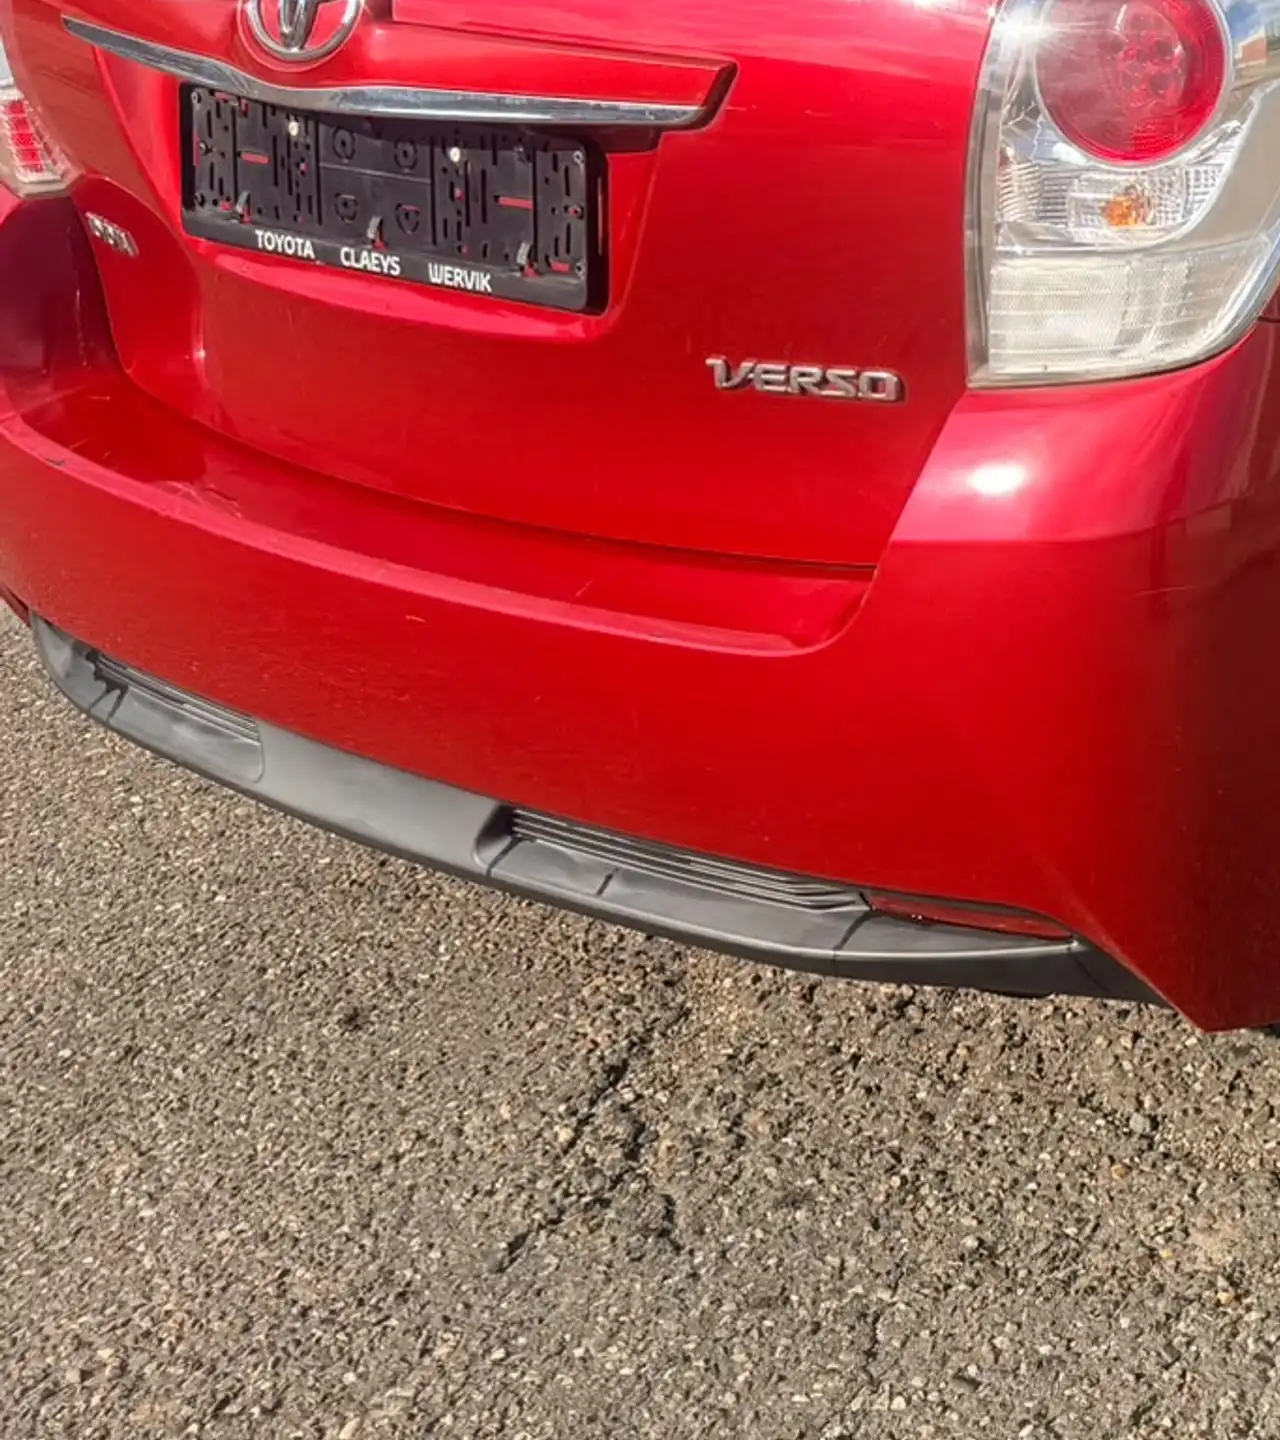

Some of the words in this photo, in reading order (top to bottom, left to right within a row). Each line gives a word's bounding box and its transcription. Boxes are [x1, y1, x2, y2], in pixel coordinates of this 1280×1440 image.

[255, 230, 315, 259] TOYOTA
[340, 247, 401, 276] CLAEYS
[428, 262, 493, 293] WERVIK
[706, 357, 900, 401] VERSO
